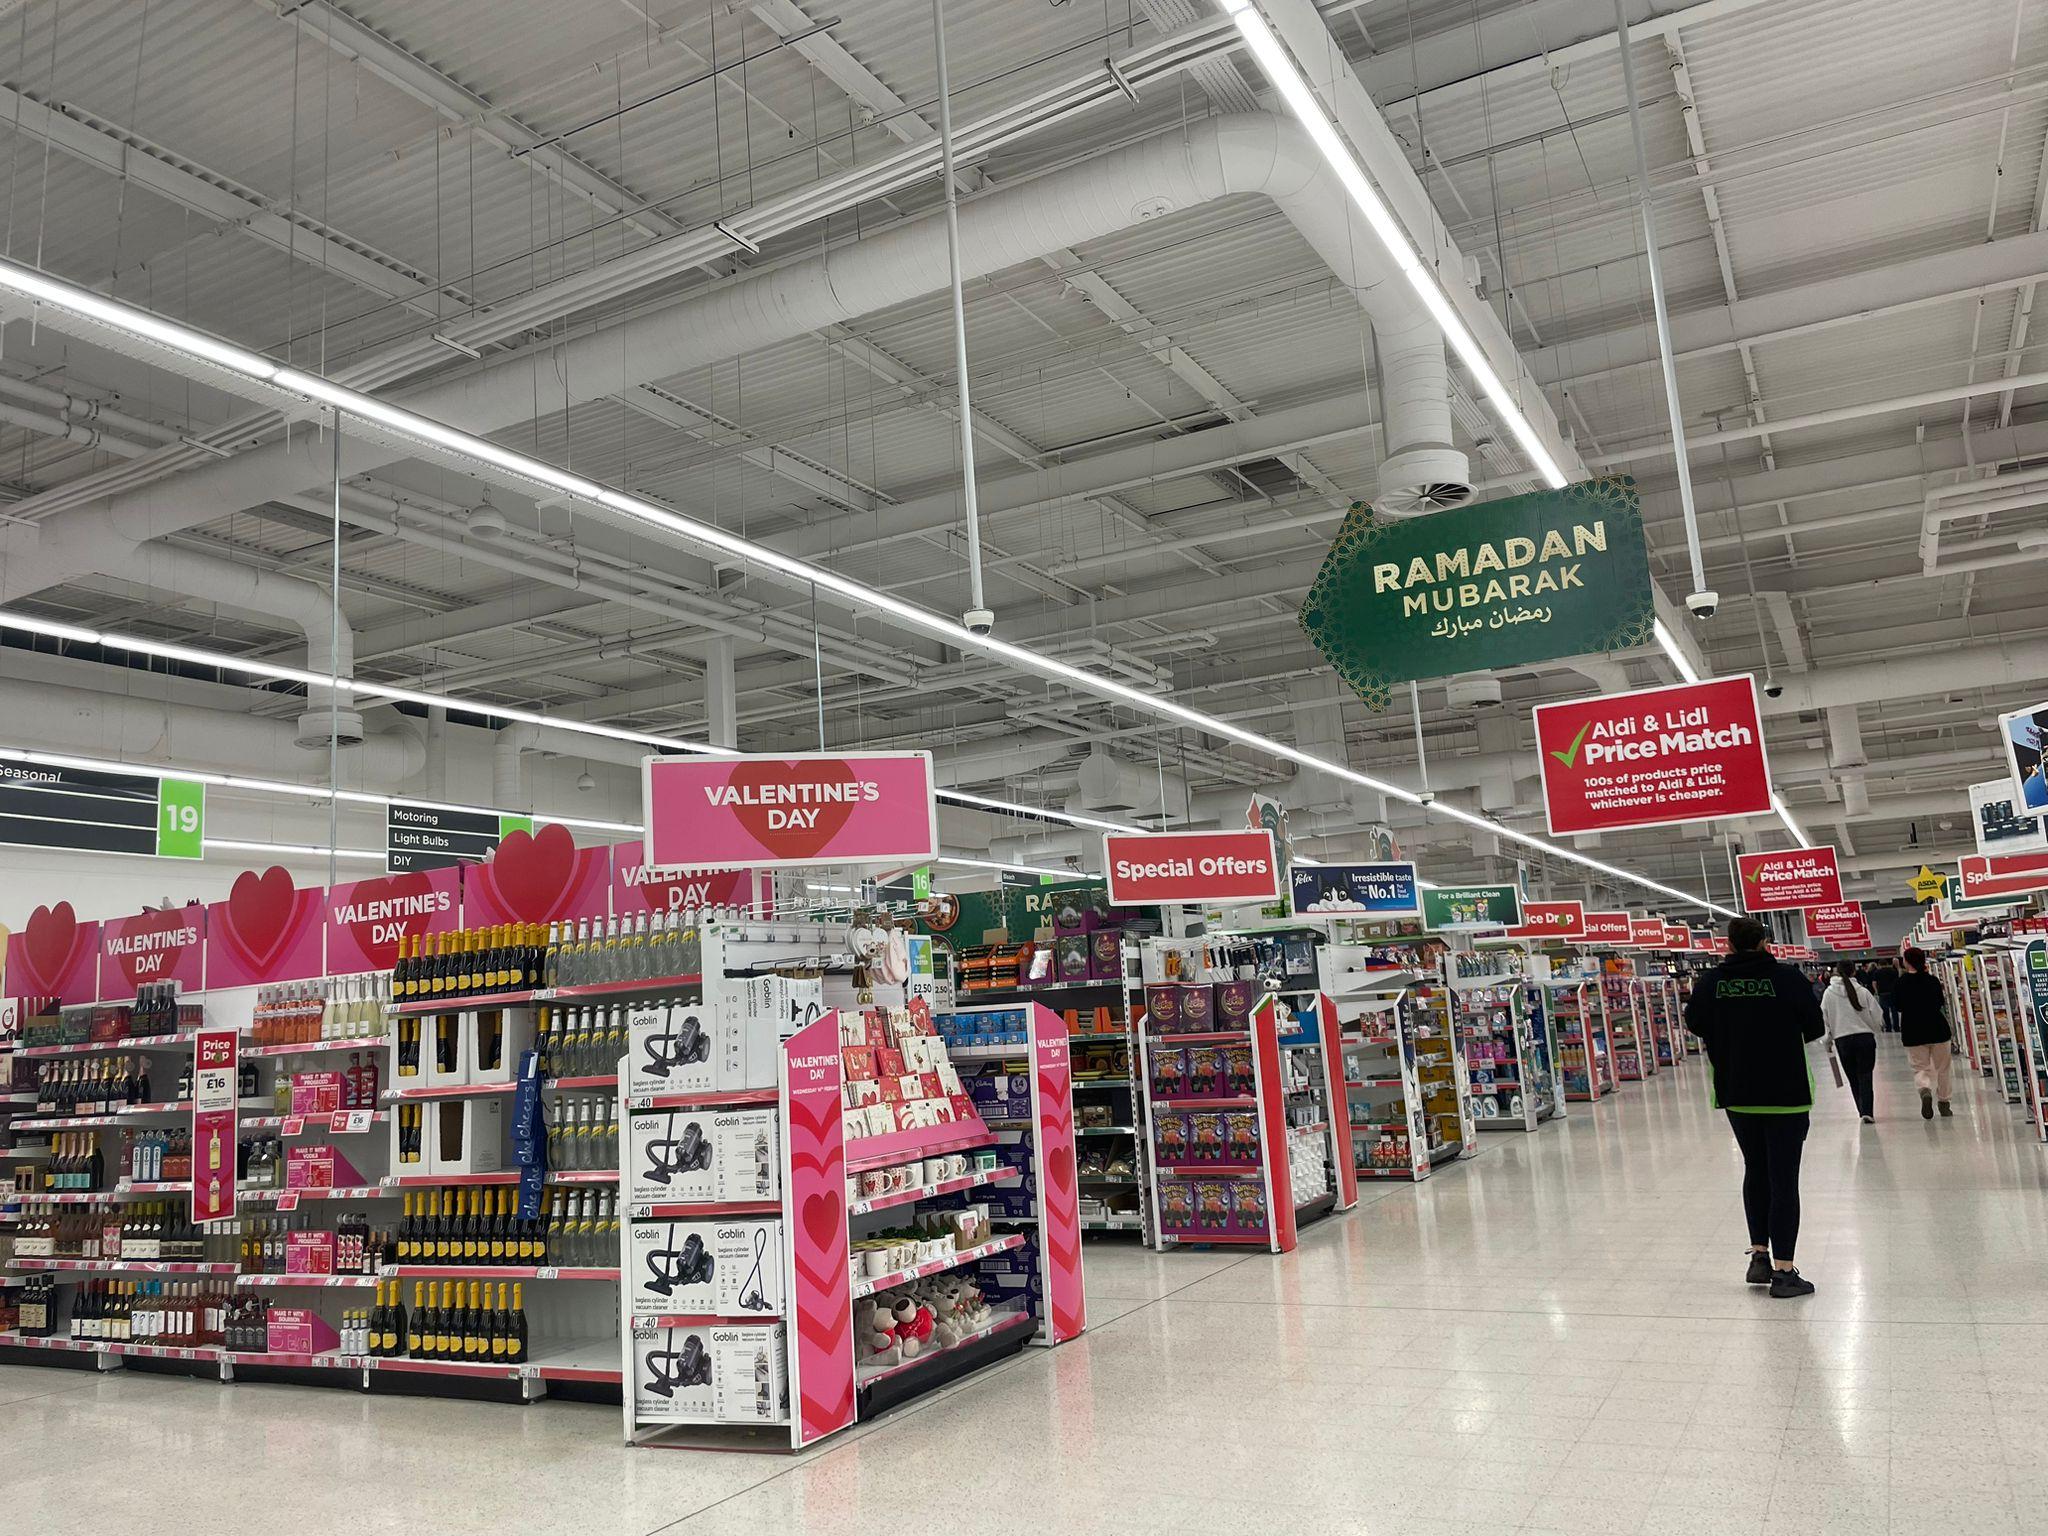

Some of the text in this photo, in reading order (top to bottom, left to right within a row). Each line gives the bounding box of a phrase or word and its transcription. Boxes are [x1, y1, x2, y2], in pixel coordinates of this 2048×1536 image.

[1373, 520, 1607, 593] RAMADAN
[1402, 563, 1585, 618] MUBARAK
[1431, 605, 1552, 639] رمضان مبارك
[1592, 706, 1709, 740] Aldi & Lidl
[1584, 723, 1752, 766] Price Match
[1584, 763, 1723, 788] 100s of products price
[704, 780, 880, 806] VALENTINE'S
[1585, 773, 1726, 800] matched to Aldi & Lidl,
[1590, 787, 1724, 811] whichever is cheaper.
[166, 804, 199, 833] 19
[394, 810, 439, 825] Motoring
[767, 808, 820, 830] DAY
[394, 833, 450, 847] Light Bulbs
[393, 855, 412, 866] DIY
[1763, 858, 1816, 871] Aldi & Lidl
[1116, 856, 1267, 882] Special Offers
[1352, 872, 1394, 882] Irresistible
[1760, 866, 1834, 882] Price Match
[915, 874, 927, 890] 16
[668, 882, 711, 908] DAY
[1368, 884, 1396, 899] No.1
[333, 891, 452, 926] VALENTINE'S
[372, 921, 408, 945] DAY
[1599, 923, 1627, 932] Offers
[106, 926, 198, 955] VALENTINE'S
[135, 953, 164, 974] DAY
[763, 979, 771, 1009] Goblin
[914, 984, 931, 993] £2.50
[1716, 979, 1776, 998] ASDA
[633, 1016, 657, 1026] Goblin
[203, 1040, 230, 1050] Price
[1051, 1049, 1060, 1058] DAY
[810, 1069, 825, 1080] DAY
[207, 1078, 226, 1089] £16
[635, 1121, 659, 1130] Goblin
[714, 1117, 740, 1127] Goblin
[635, 1230, 659, 1239] Goblin
[717, 1229, 745, 1239] Goblin
[633, 1330, 659, 1340] Goblin
[713, 1332, 739, 1342] Goblin
